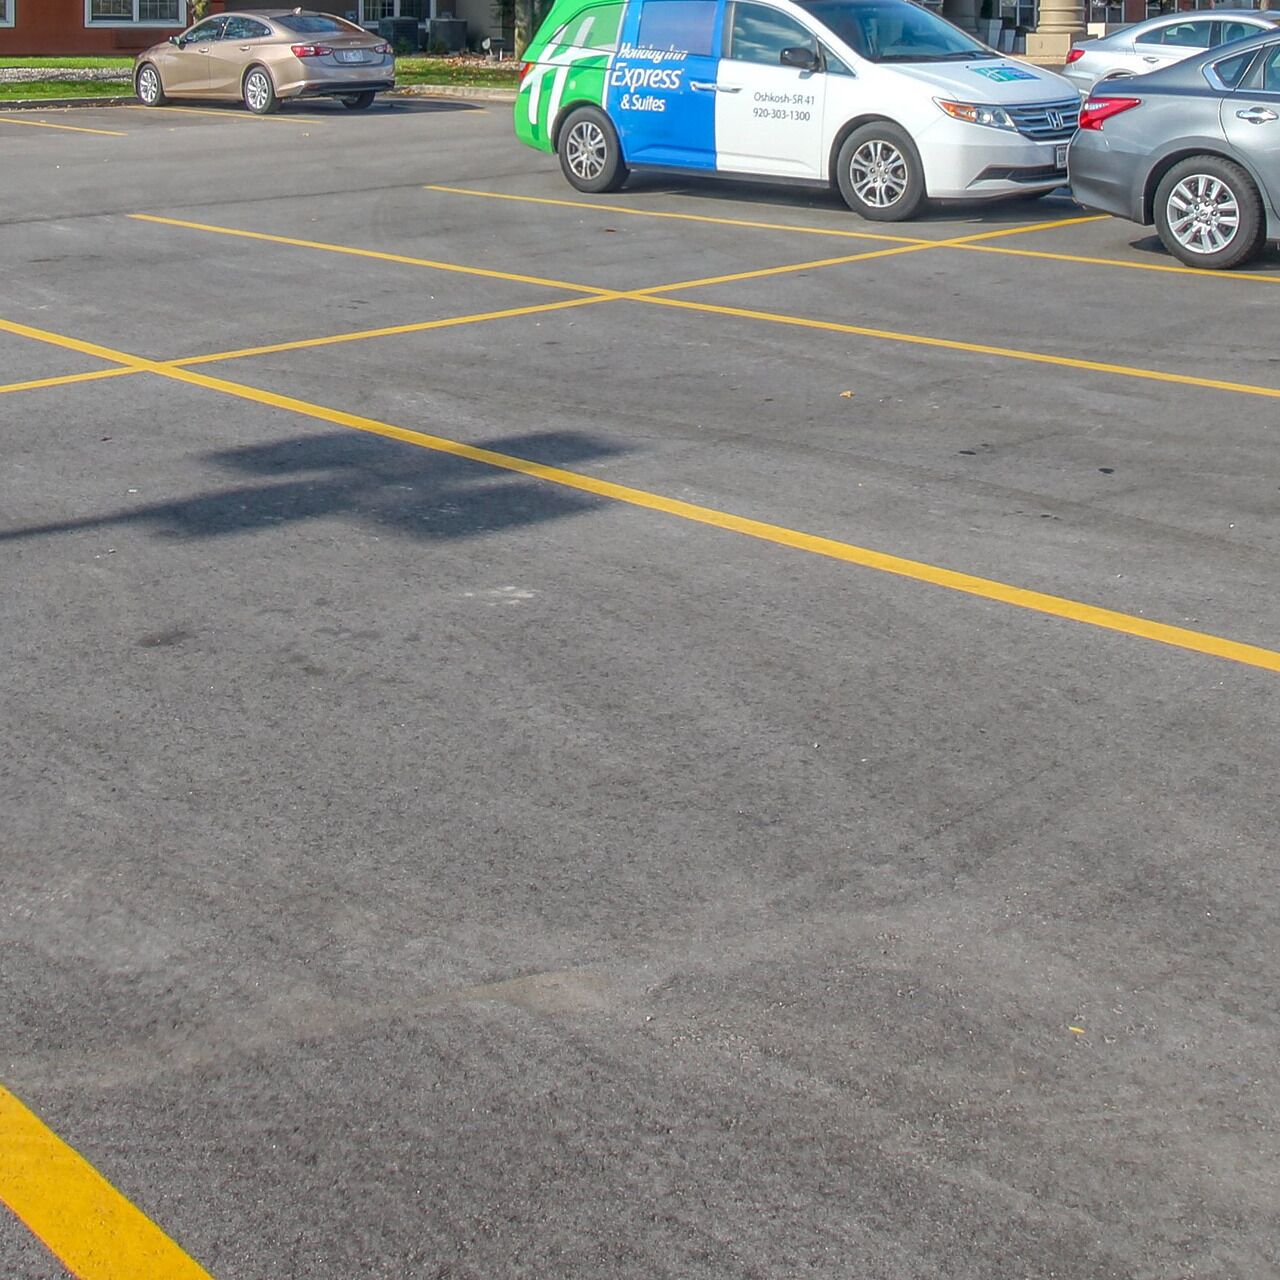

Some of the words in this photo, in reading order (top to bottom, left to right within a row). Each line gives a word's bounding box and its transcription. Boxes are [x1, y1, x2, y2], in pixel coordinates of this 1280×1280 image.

[617, 42, 665, 64] Holiday
[610, 62, 682, 93] Express
[620, 93, 630, 110] &
[631, 94, 666, 112] Suites
[753, 107, 811, 121] 920-303-1300
